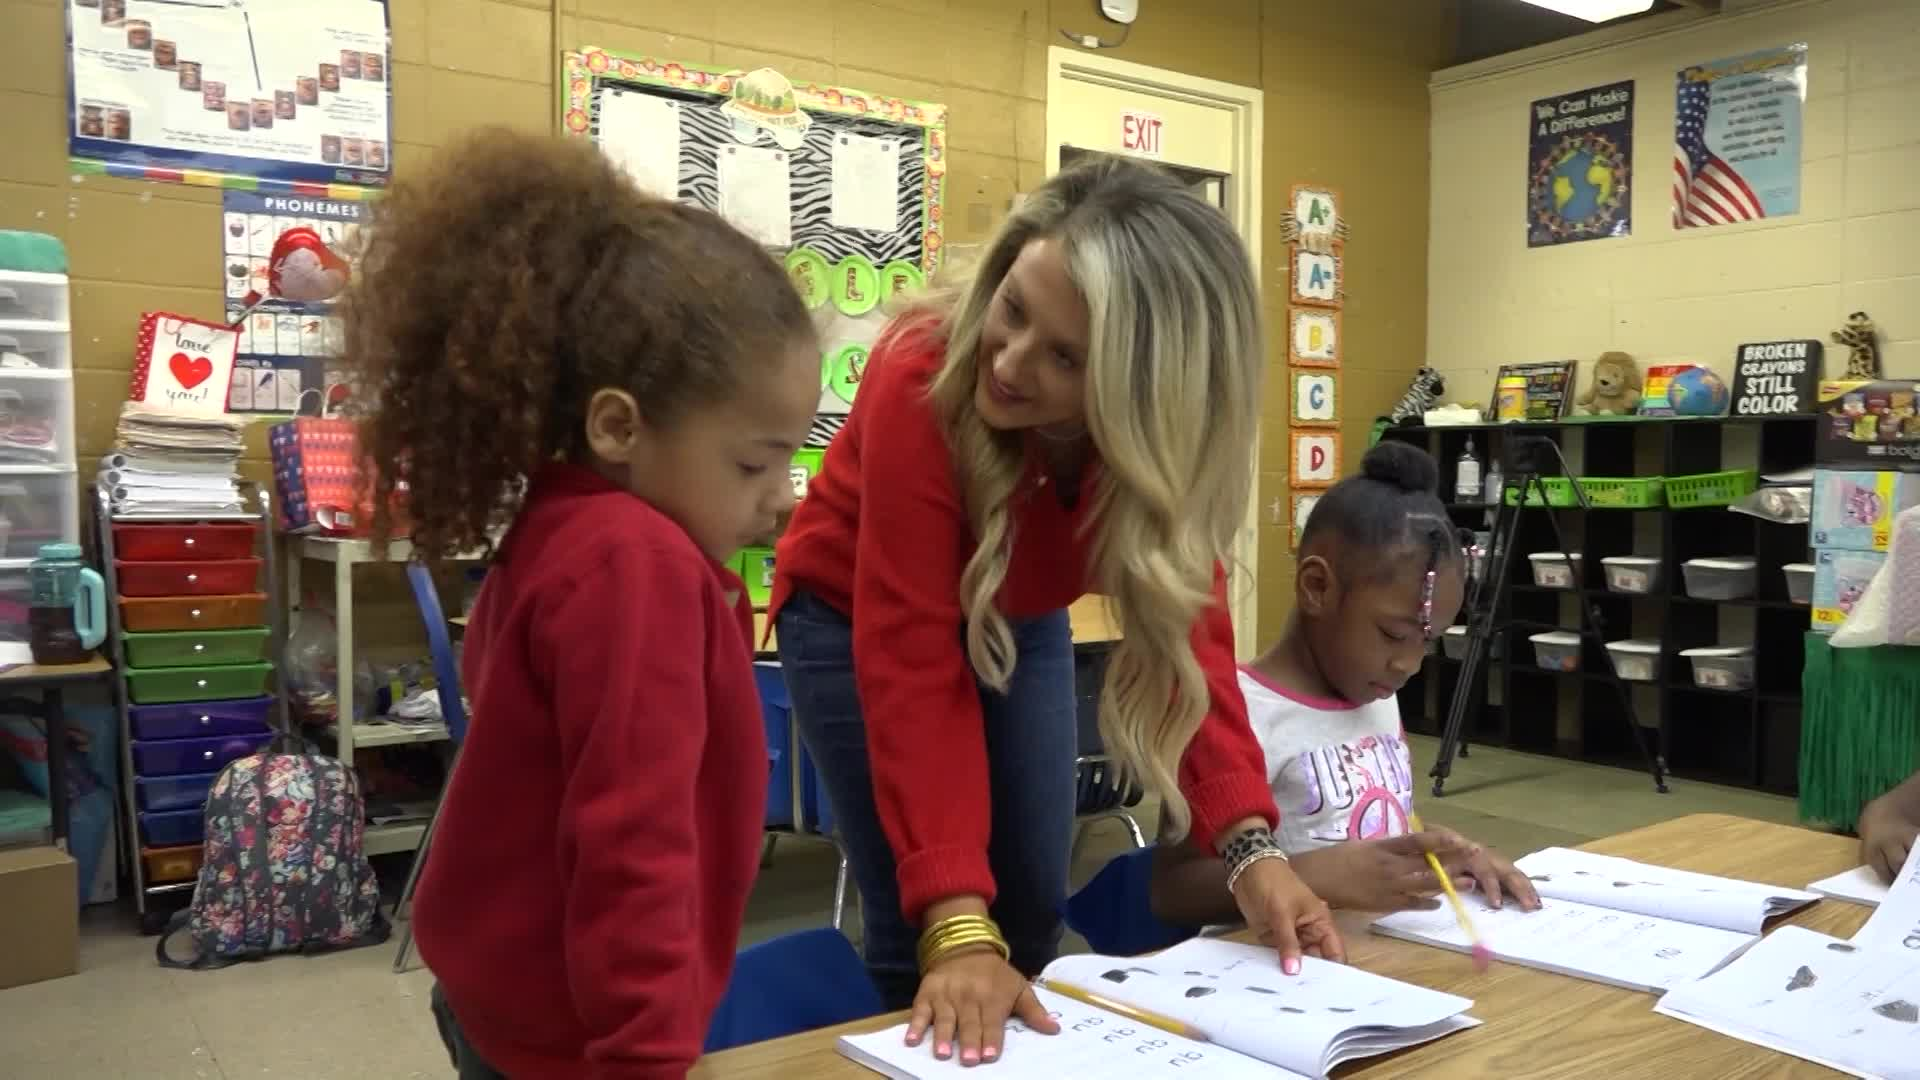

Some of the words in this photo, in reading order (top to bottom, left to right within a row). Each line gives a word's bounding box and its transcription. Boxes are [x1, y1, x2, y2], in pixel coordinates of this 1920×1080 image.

[1536, 104, 1555, 119] We
[1559, 99, 1586, 114] Can
[1589, 88, 1629, 108] Make
[1123, 115, 1162, 152] EXIT
[1538, 122, 1548, 137] A
[1550, 105, 1626, 134] Difference!
[264, 197, 360, 217] PHONEMES
[1308, 197, 1331, 226] A+
[1309, 325, 1323, 351] B
[1743, 343, 1808, 361] BROKEN
[1741, 359, 1806, 376] CRAYONS
[1309, 383, 1324, 410] C
[1745, 375, 1796, 395] STILL
[1738, 394, 1799, 414] COLOR
[1309, 445, 1325, 472] D
